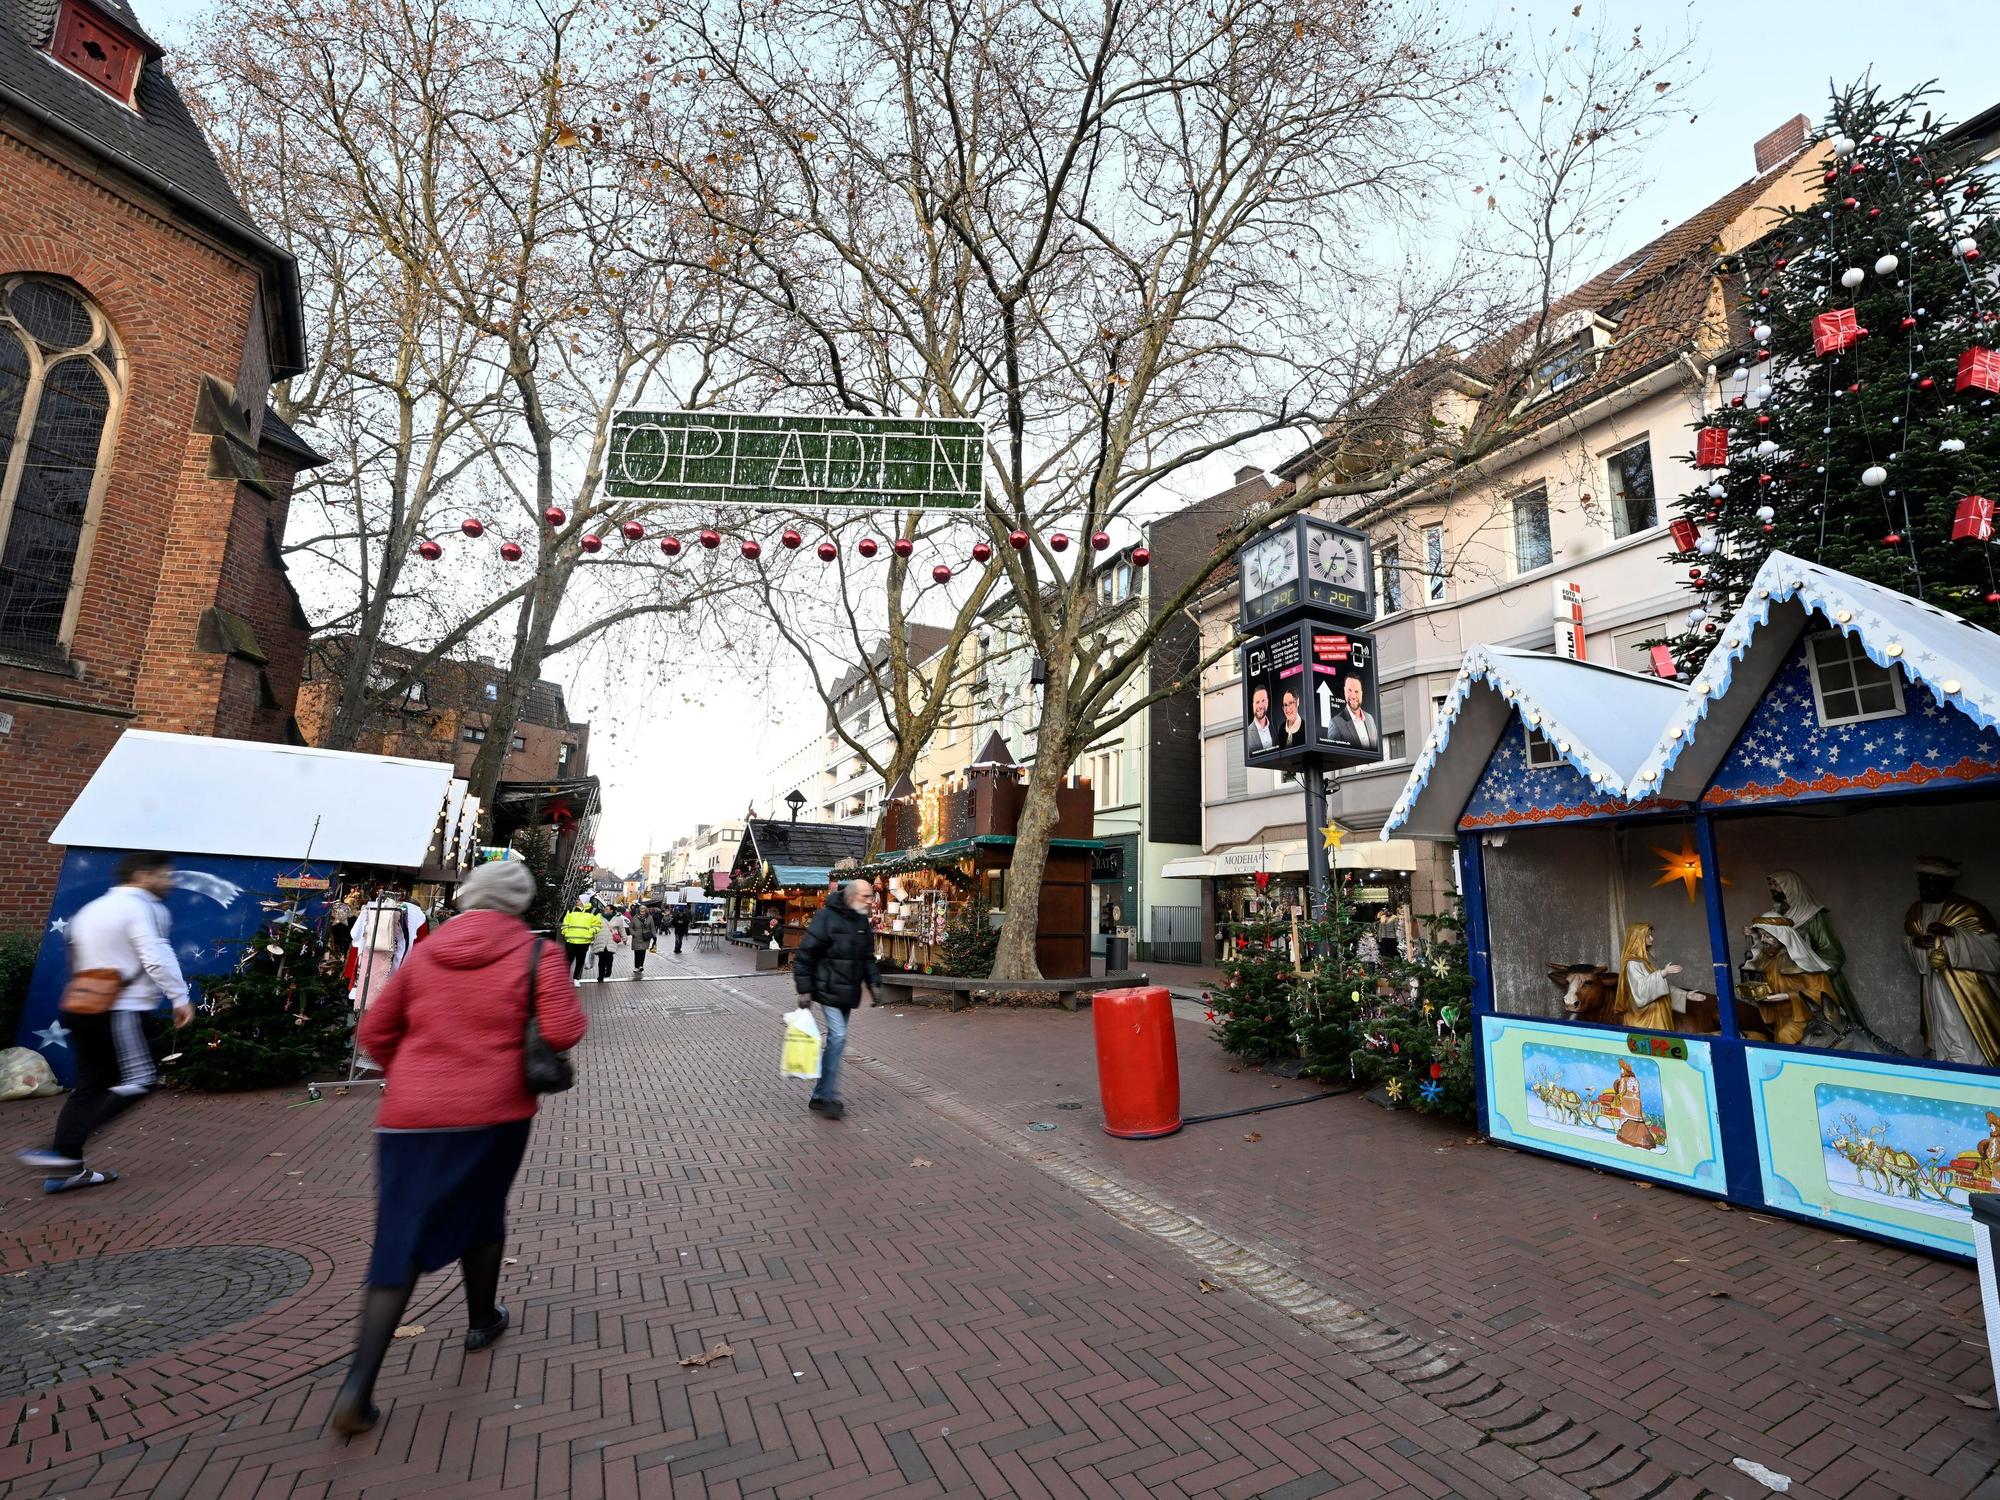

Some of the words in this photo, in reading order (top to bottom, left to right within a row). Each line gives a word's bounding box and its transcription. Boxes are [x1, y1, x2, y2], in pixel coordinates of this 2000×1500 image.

[622, 423, 968, 498] OPLADEN
[1562, 589, 1576, 598] FOTO
[1566, 631, 1575, 659] FILM
